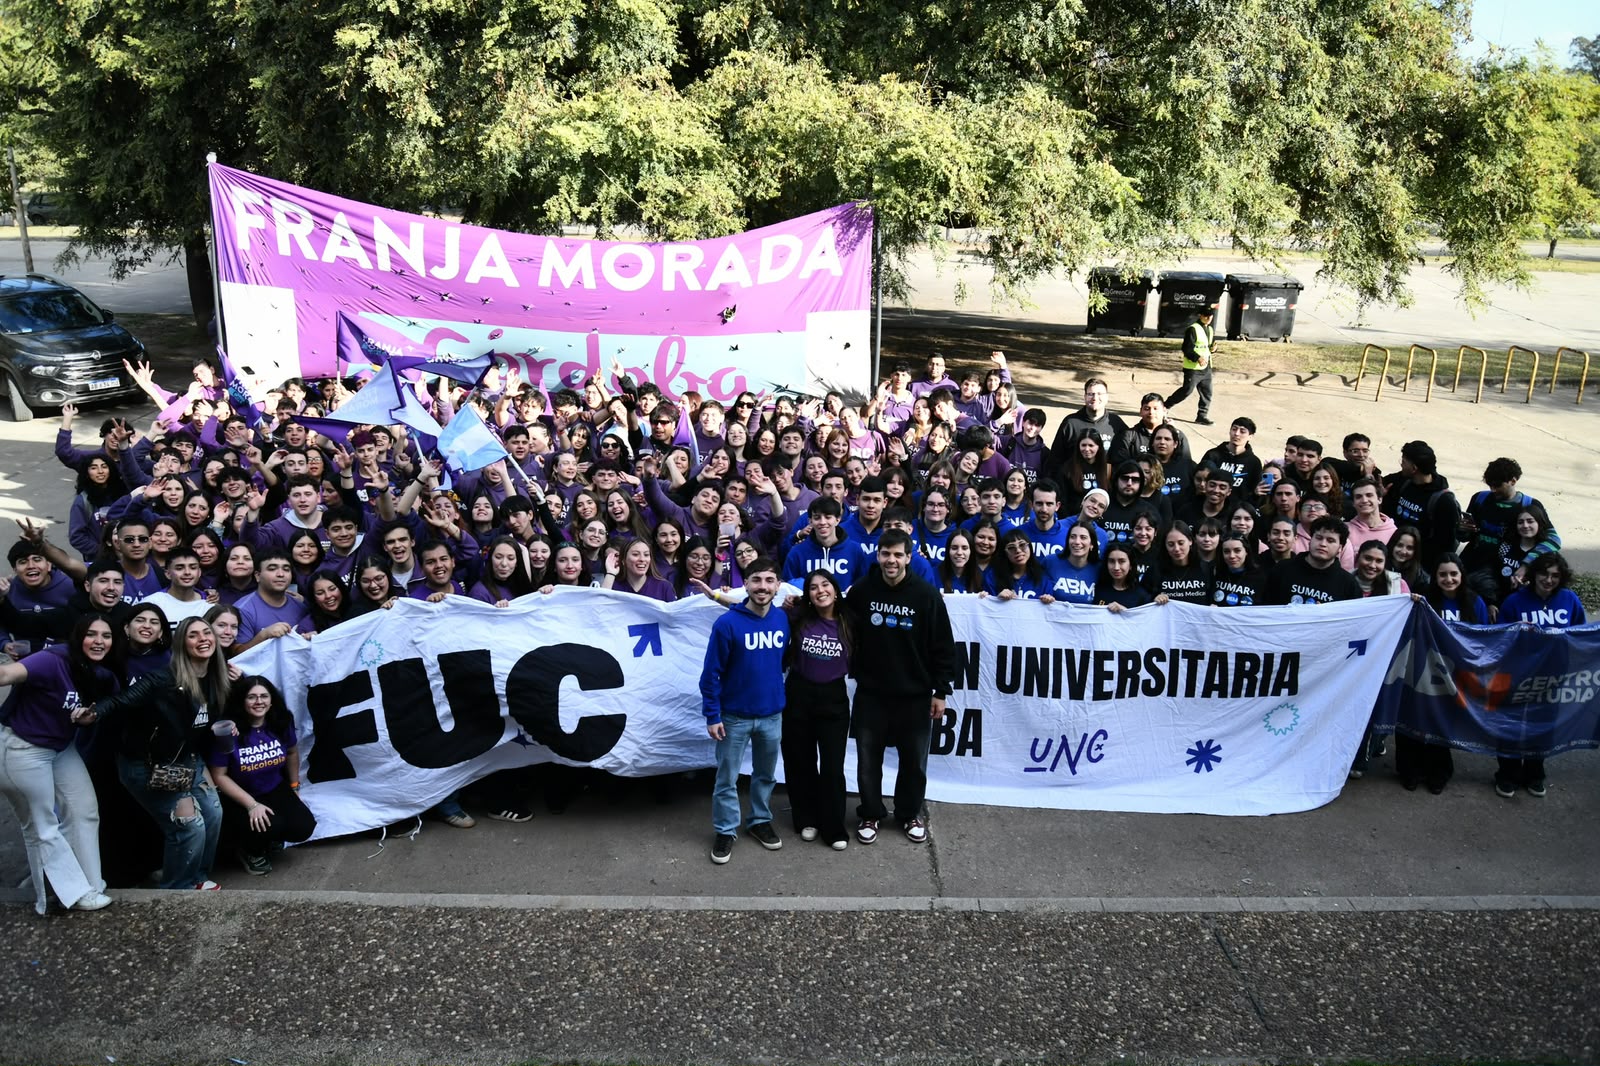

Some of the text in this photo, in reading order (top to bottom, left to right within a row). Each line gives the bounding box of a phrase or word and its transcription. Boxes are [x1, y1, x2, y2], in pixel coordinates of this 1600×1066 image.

[233, 187, 843, 292] FRANJA MORADA
[1220, 462, 1245, 475] NIKE
[1104, 521, 1132, 531] SUMA
[806, 558, 849, 575] UNC
[1053, 577, 1096, 597] ABM
[1161, 580, 1206, 590] SUMAR+
[1215, 580, 1256, 596] SUMAR+
[1291, 584, 1334, 602] SUMAR+
[869, 601, 916, 617] SUMAR+
[1521, 608, 1568, 627] UNC
[744, 630, 784, 650] UNC
[802, 637, 843, 651] FRANJA
[801, 644, 841, 657] MORADA
[995, 644, 1301, 702] UNIVERSITARIA
[1512, 687, 1600, 704] ESTUDIA
[306, 642, 627, 784] FUC
[238, 739, 281, 756] FRANJA
[1023, 729, 1109, 775] UNC
[240, 748, 284, 765] MORADA
